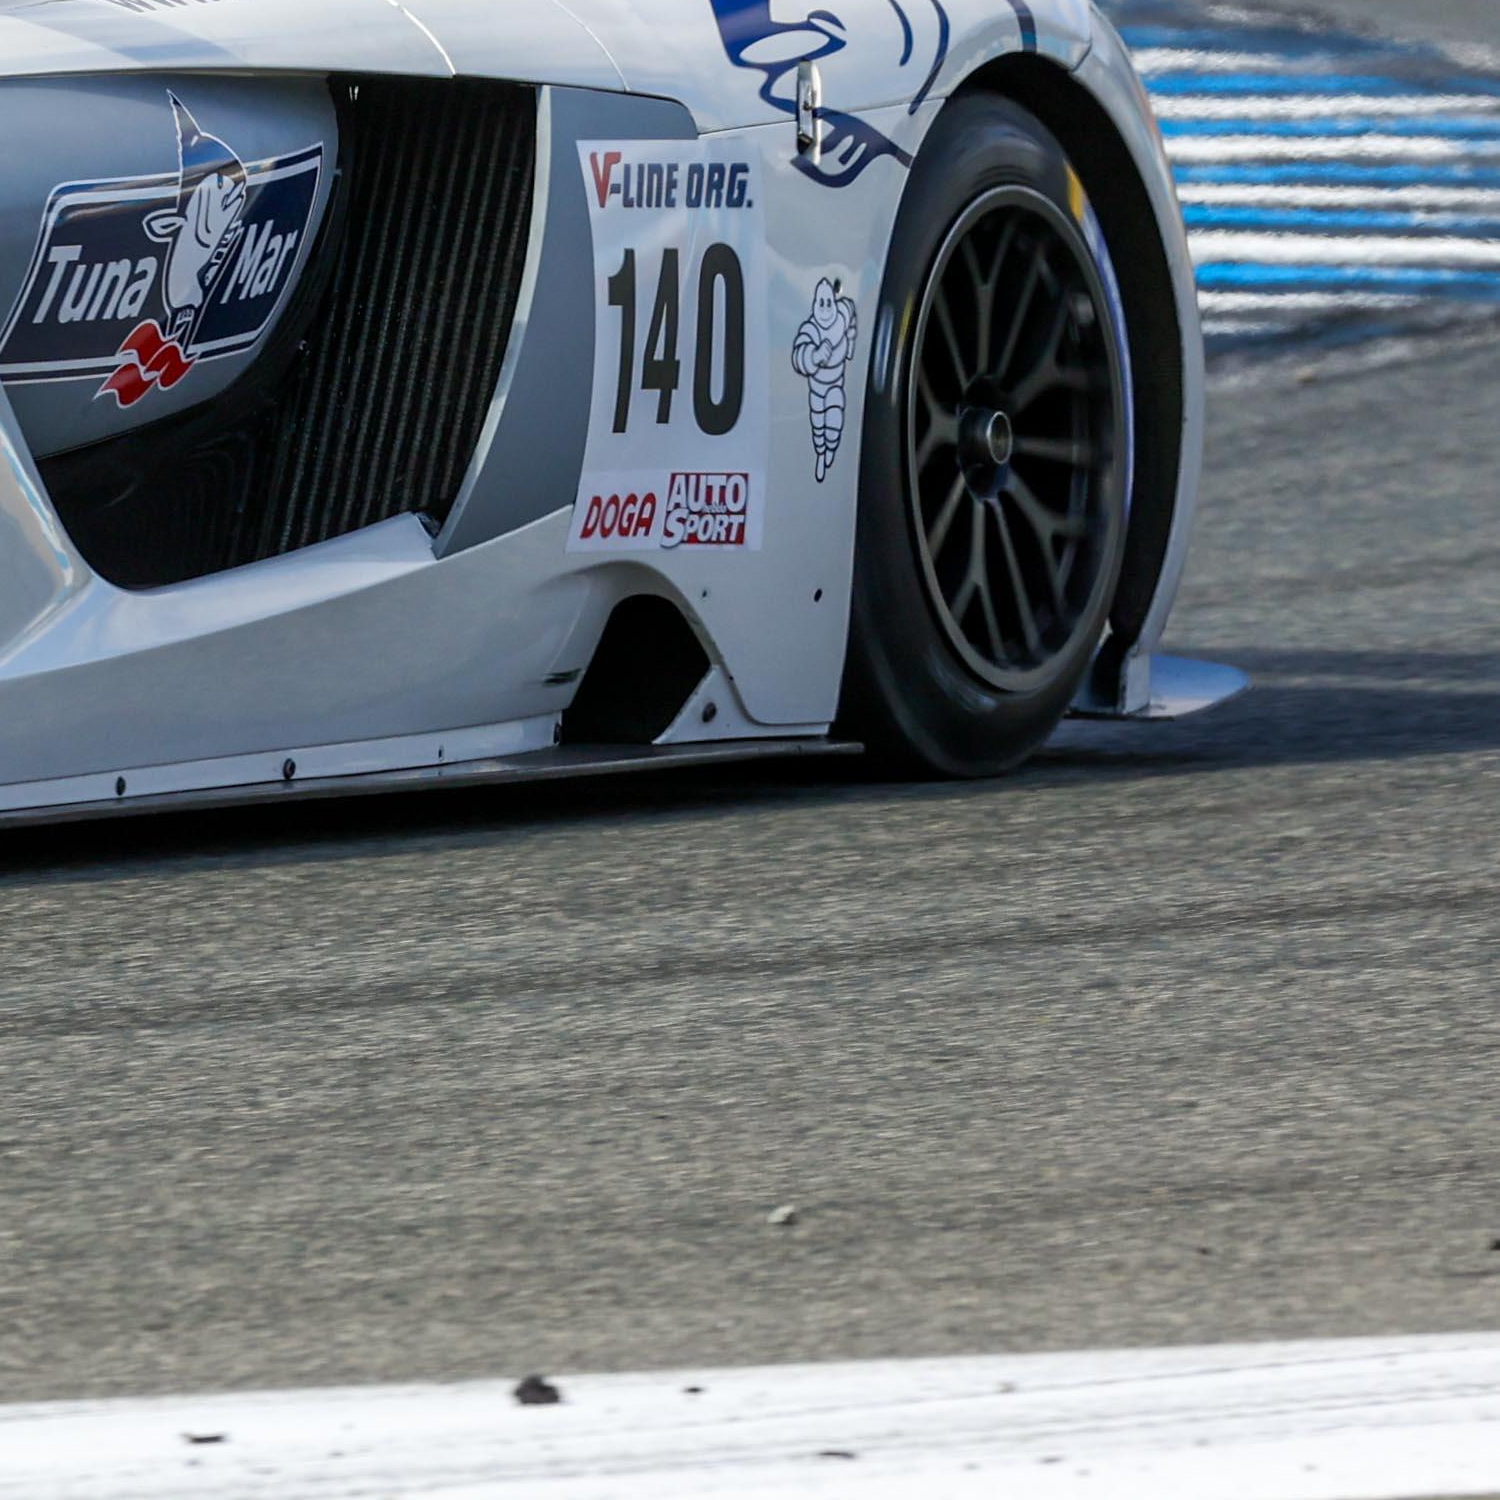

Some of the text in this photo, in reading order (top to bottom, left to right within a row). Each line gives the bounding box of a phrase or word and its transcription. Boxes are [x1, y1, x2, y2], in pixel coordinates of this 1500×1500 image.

[589, 151, 753, 209] V-LINE ORG.
[32, 219, 298, 324] Tuna Mar
[607, 242, 745, 436] 140
[579, 492, 656, 540] DOGA
[667, 473, 747, 514] AUTO
[660, 508, 745, 549] SPORT
